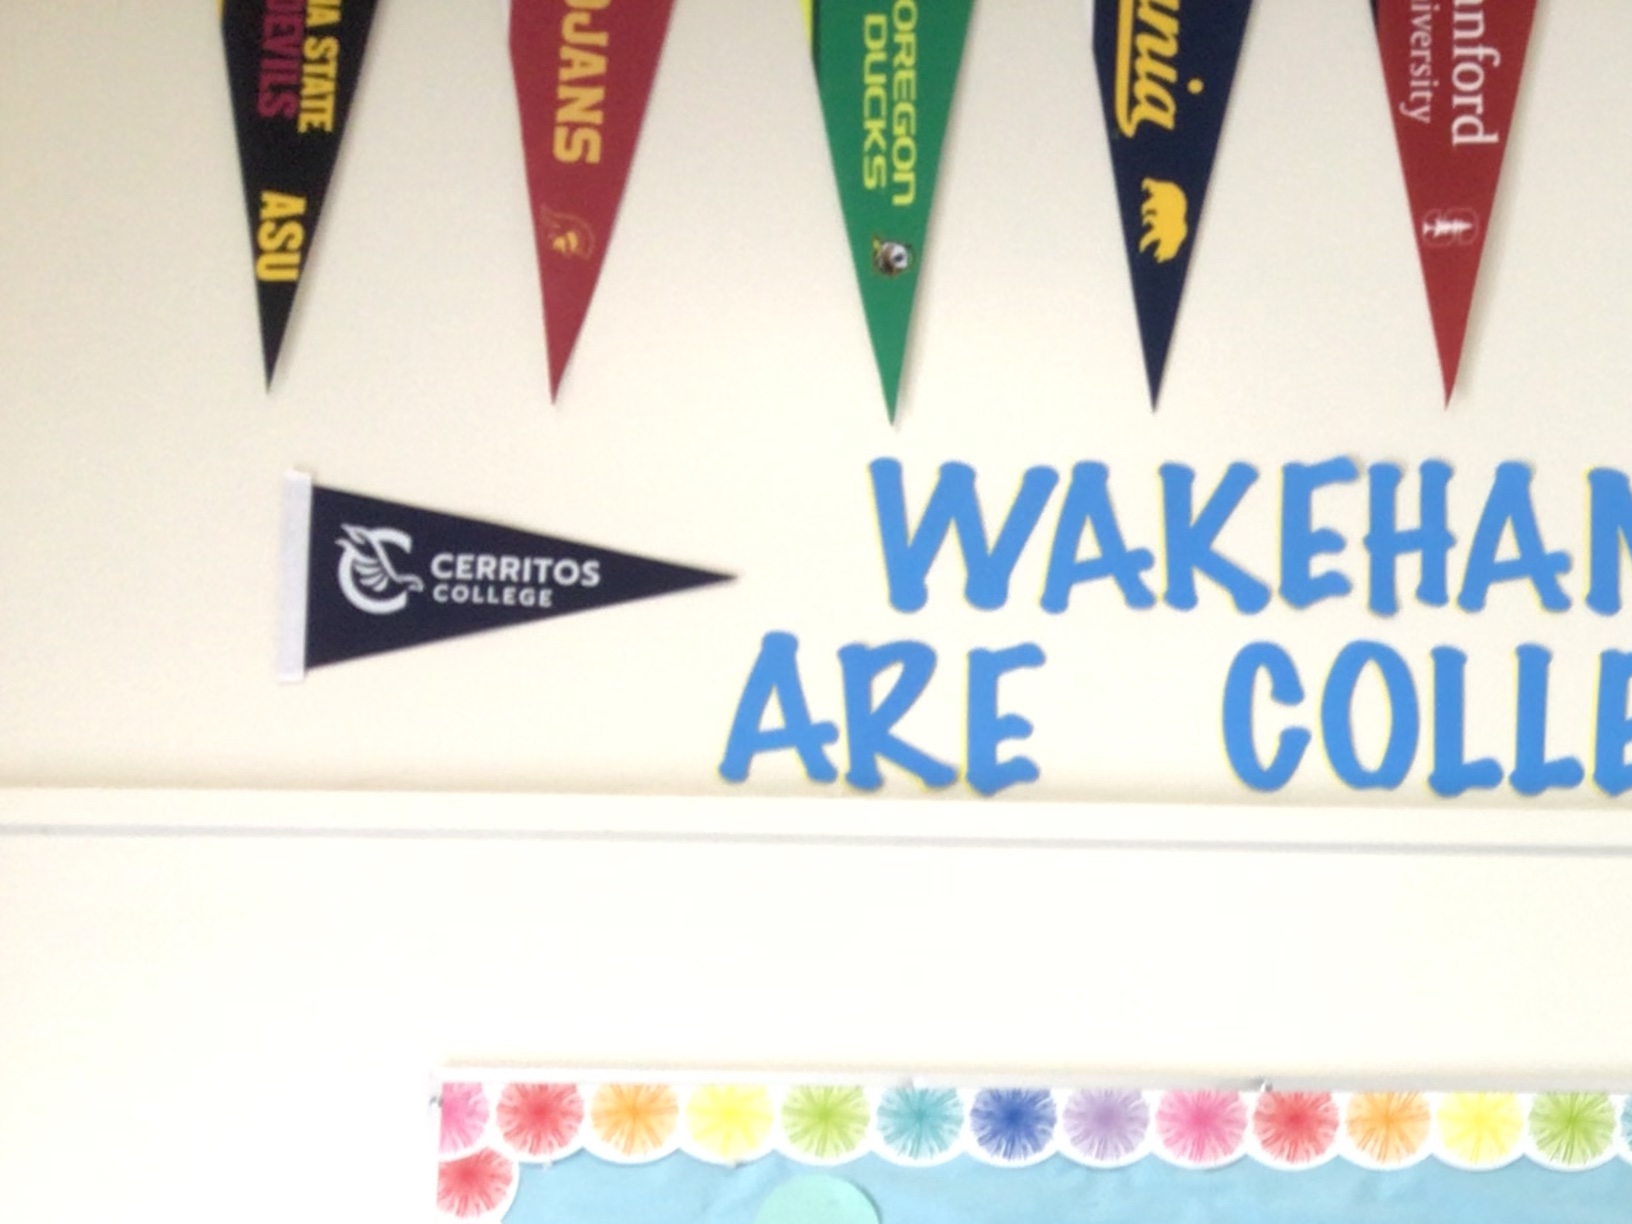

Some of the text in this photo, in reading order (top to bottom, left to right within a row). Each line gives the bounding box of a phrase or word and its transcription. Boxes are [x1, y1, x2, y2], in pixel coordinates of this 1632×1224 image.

[297, 38, 340, 132] STATE
[552, 0, 608, 164] JANS
[863, 14, 887, 191] DUCKS
[892, 0, 916, 206] OREGON
[1114, 0, 1204, 138] nia
[1399, 0, 1440, 124] iversity
[255, 191, 305, 282] ASU
[430, 553, 601, 588] CERRITOS
[433, 583, 553, 608] COLLEGE
[719, 630, 1047, 797] ARE
